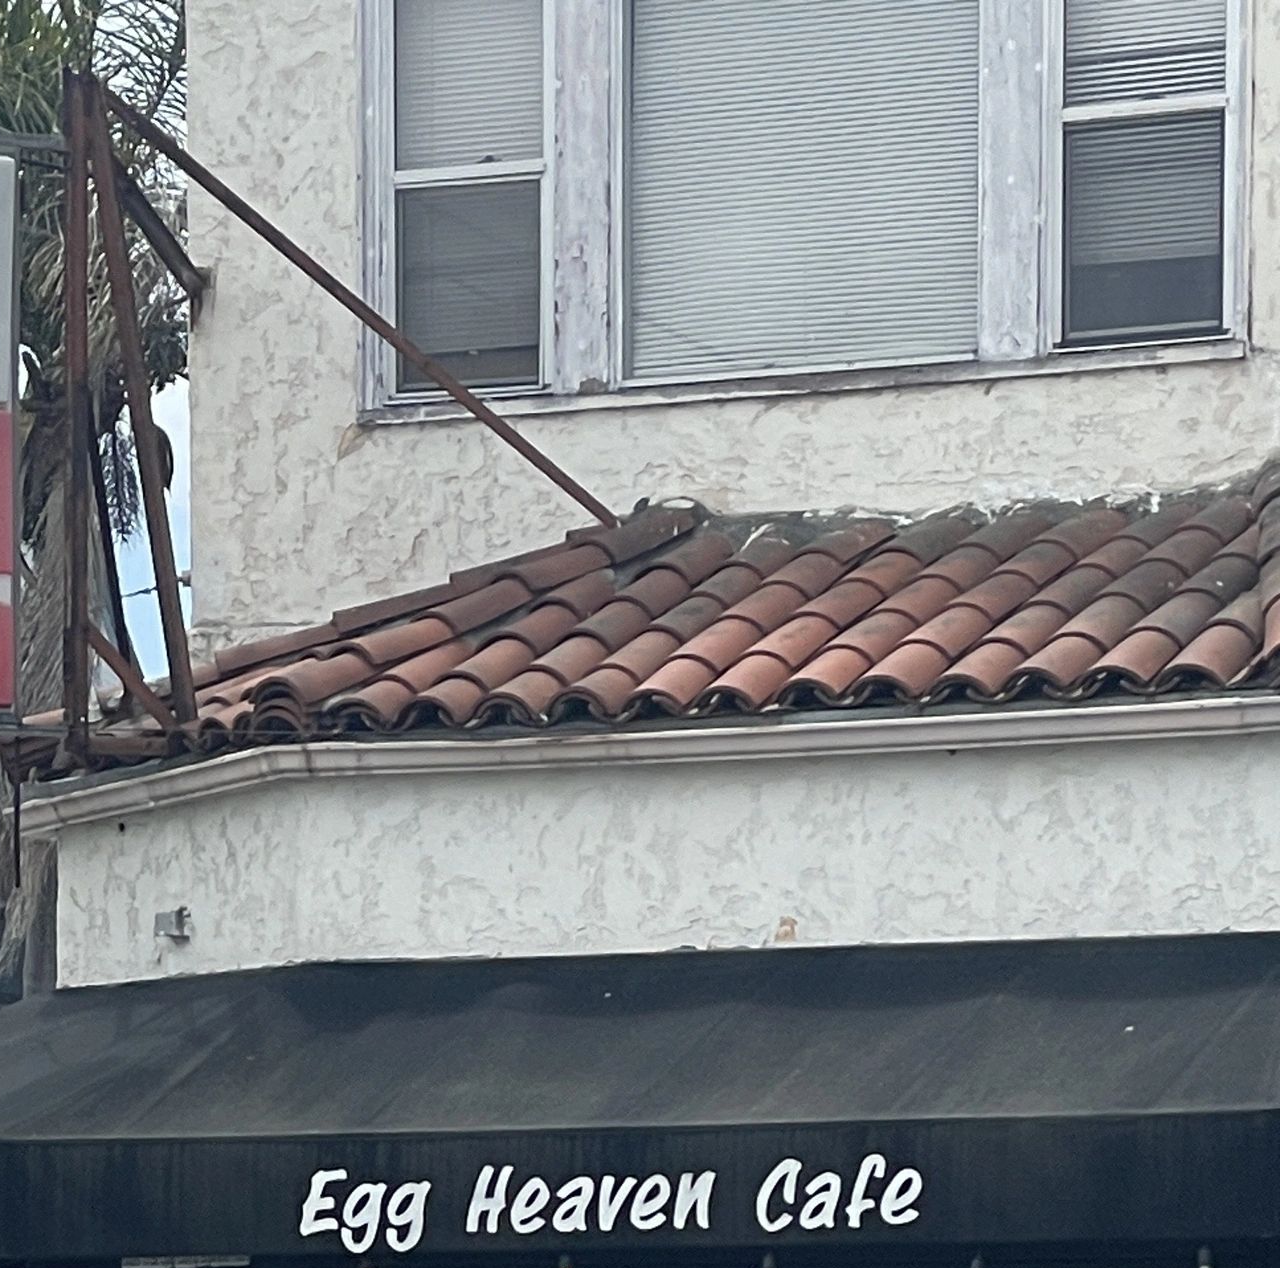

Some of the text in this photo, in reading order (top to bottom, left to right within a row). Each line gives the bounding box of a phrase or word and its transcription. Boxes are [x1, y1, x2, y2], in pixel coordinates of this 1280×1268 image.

[299, 1153, 923, 1254] Egg Heaven Cafe
